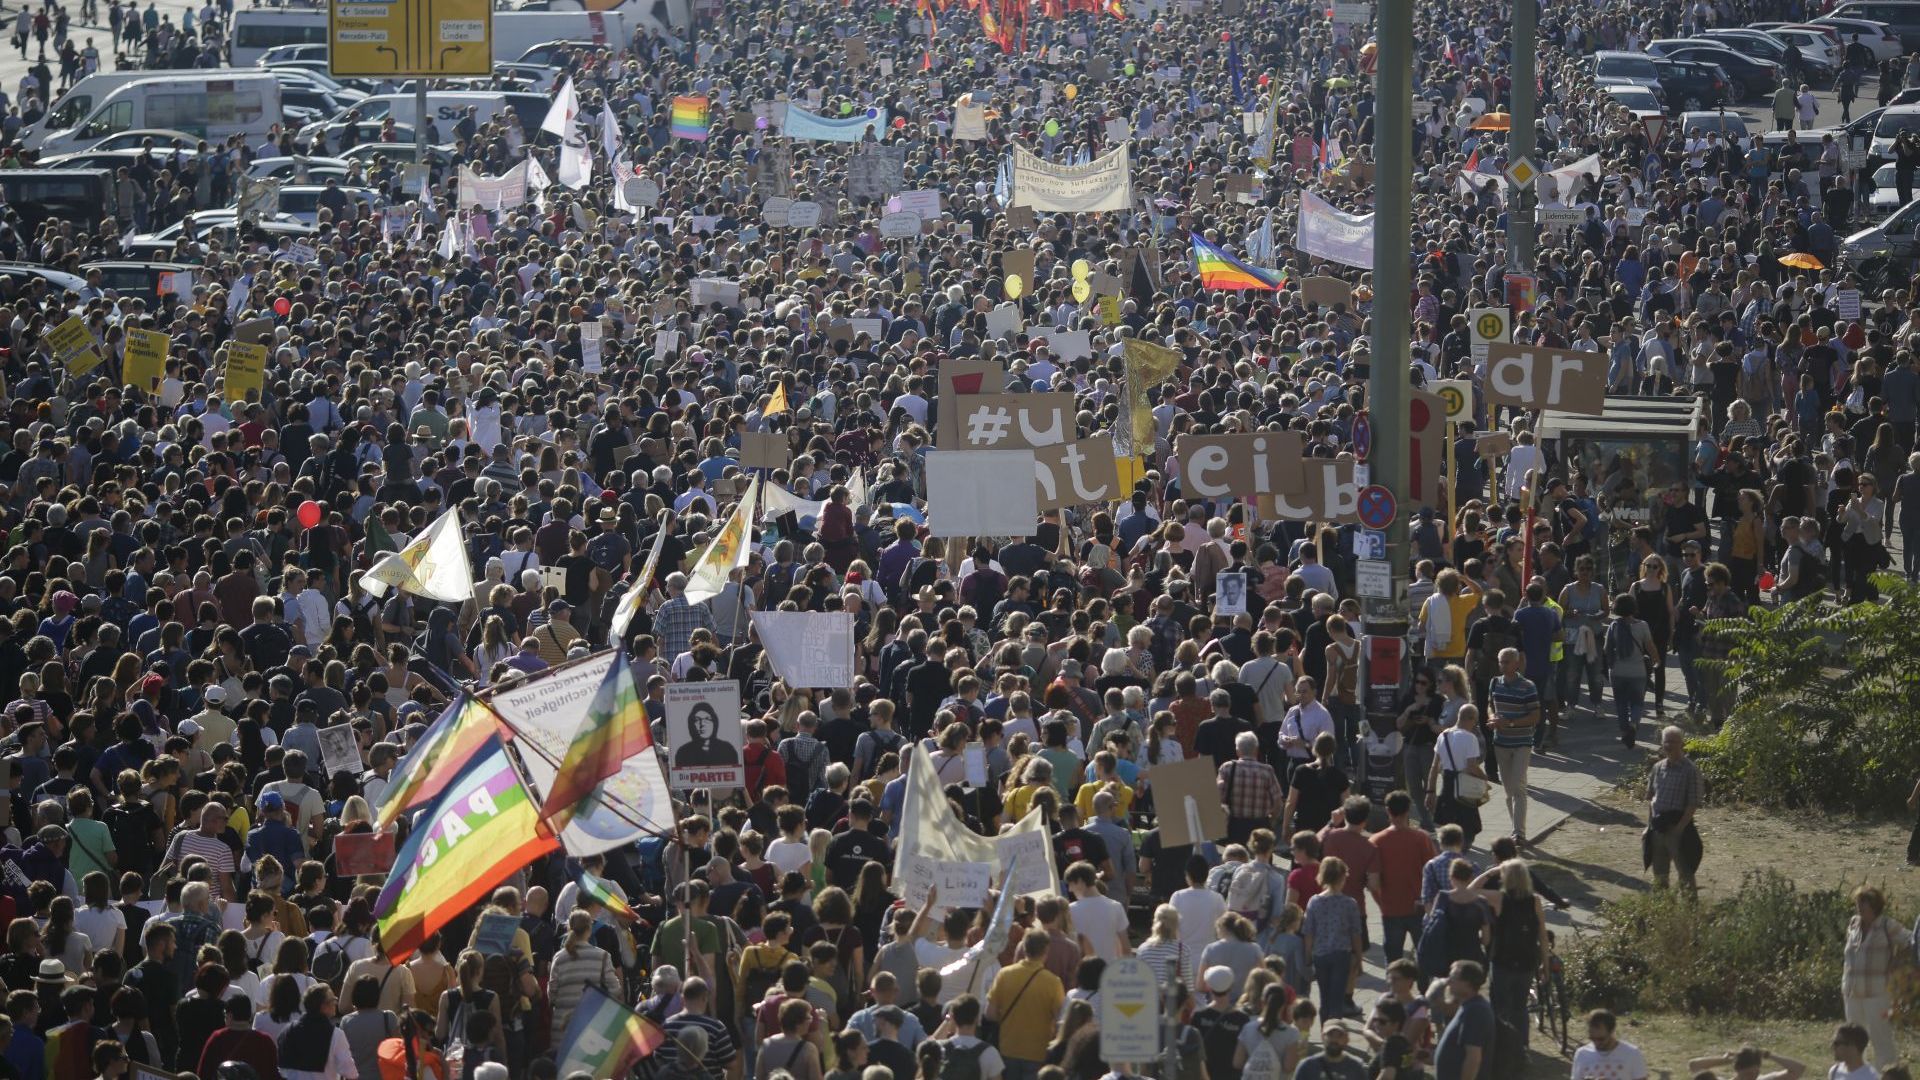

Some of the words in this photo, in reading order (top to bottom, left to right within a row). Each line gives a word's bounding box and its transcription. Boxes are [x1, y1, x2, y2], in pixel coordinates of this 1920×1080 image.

[337, 20, 369, 28] Treptow
[442, 22, 464, 30] Unter
[467, 22, 482, 30] den
[339, 32, 386, 40] Mercedes-Platz
[442, 32, 469, 40] Linden
[967, 405, 1064, 447] #u
[1187, 437, 1271, 497] ei
[1613, 507, 1650, 520] Wall
[678, 687, 701, 695] Hoffnung
[679, 772, 689, 780] Die
[689, 771, 736, 783] PARTEI
[1120, 961, 1137, 974] 28
